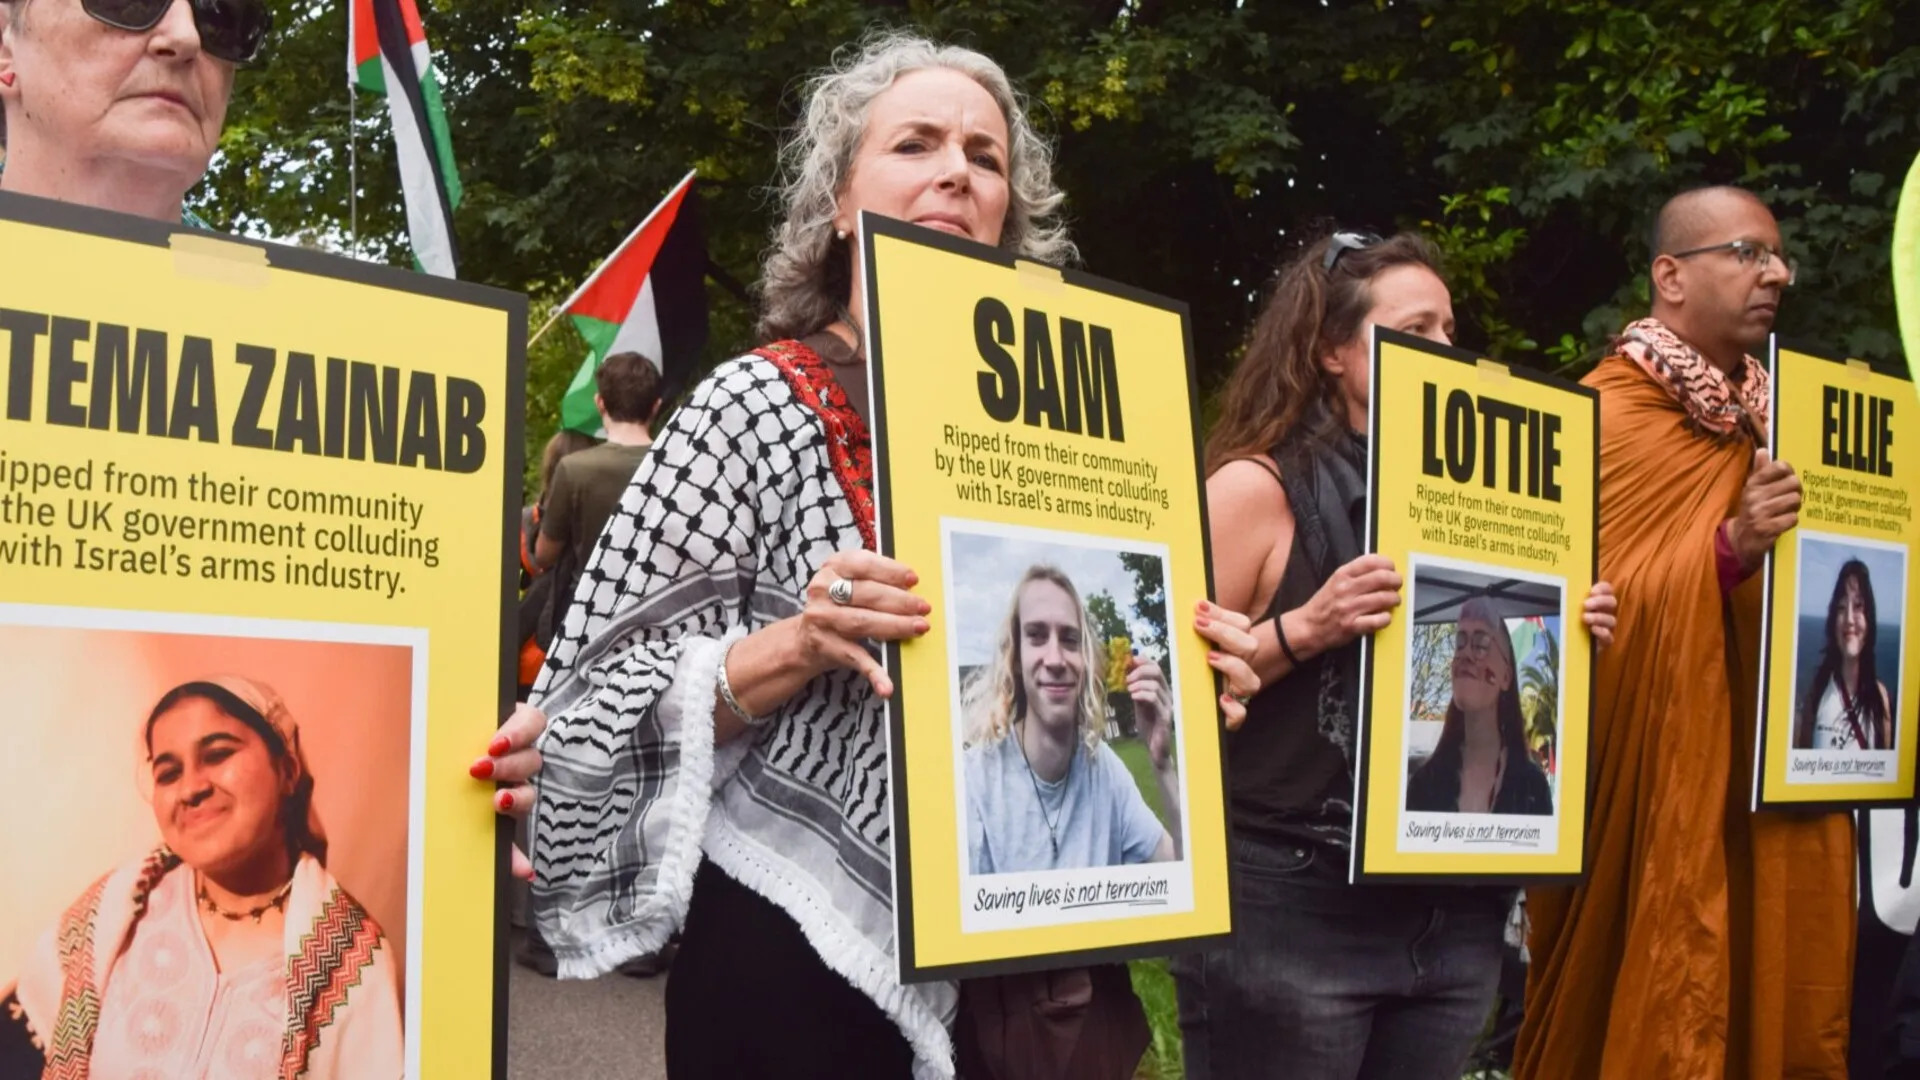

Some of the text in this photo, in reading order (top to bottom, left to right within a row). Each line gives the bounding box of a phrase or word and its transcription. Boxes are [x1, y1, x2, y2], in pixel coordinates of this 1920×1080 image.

[0, 308, 487, 474] TEMA ZAINAB
[973, 296, 1125, 443] SAM
[944, 424, 1158, 484] Ripped from their community
[1422, 381, 1562, 504] LOTTIE
[1822, 384, 1894, 477] ELLIE
[0, 450, 424, 530] ipped from their community
[935, 448, 1169, 509] by the UK government colluding
[956, 480, 991, 503] with
[1056, 498, 1092, 517] arms
[1095, 497, 1155, 530] industry.
[1803, 470, 1908, 505] Ripped from their community
[1, 492, 440, 568] the UK government colluding
[1409, 502, 1570, 551] by the UK government colluding
[1416, 484, 1565, 530] Ripped from their community
[1422, 527, 1445, 543] with
[1489, 540, 1515, 555] arms
[1517, 543, 1559, 566] industry.
[201, 555, 275, 583] arms
[286, 554, 406, 599] industry.
[1406, 820, 1441, 842] Saving
[1443, 820, 1464, 839] lives
[1466, 822, 1475, 839] is
[1476, 823, 1495, 839] not
[974, 876, 1169, 914] Saving lives is not terrorism.
